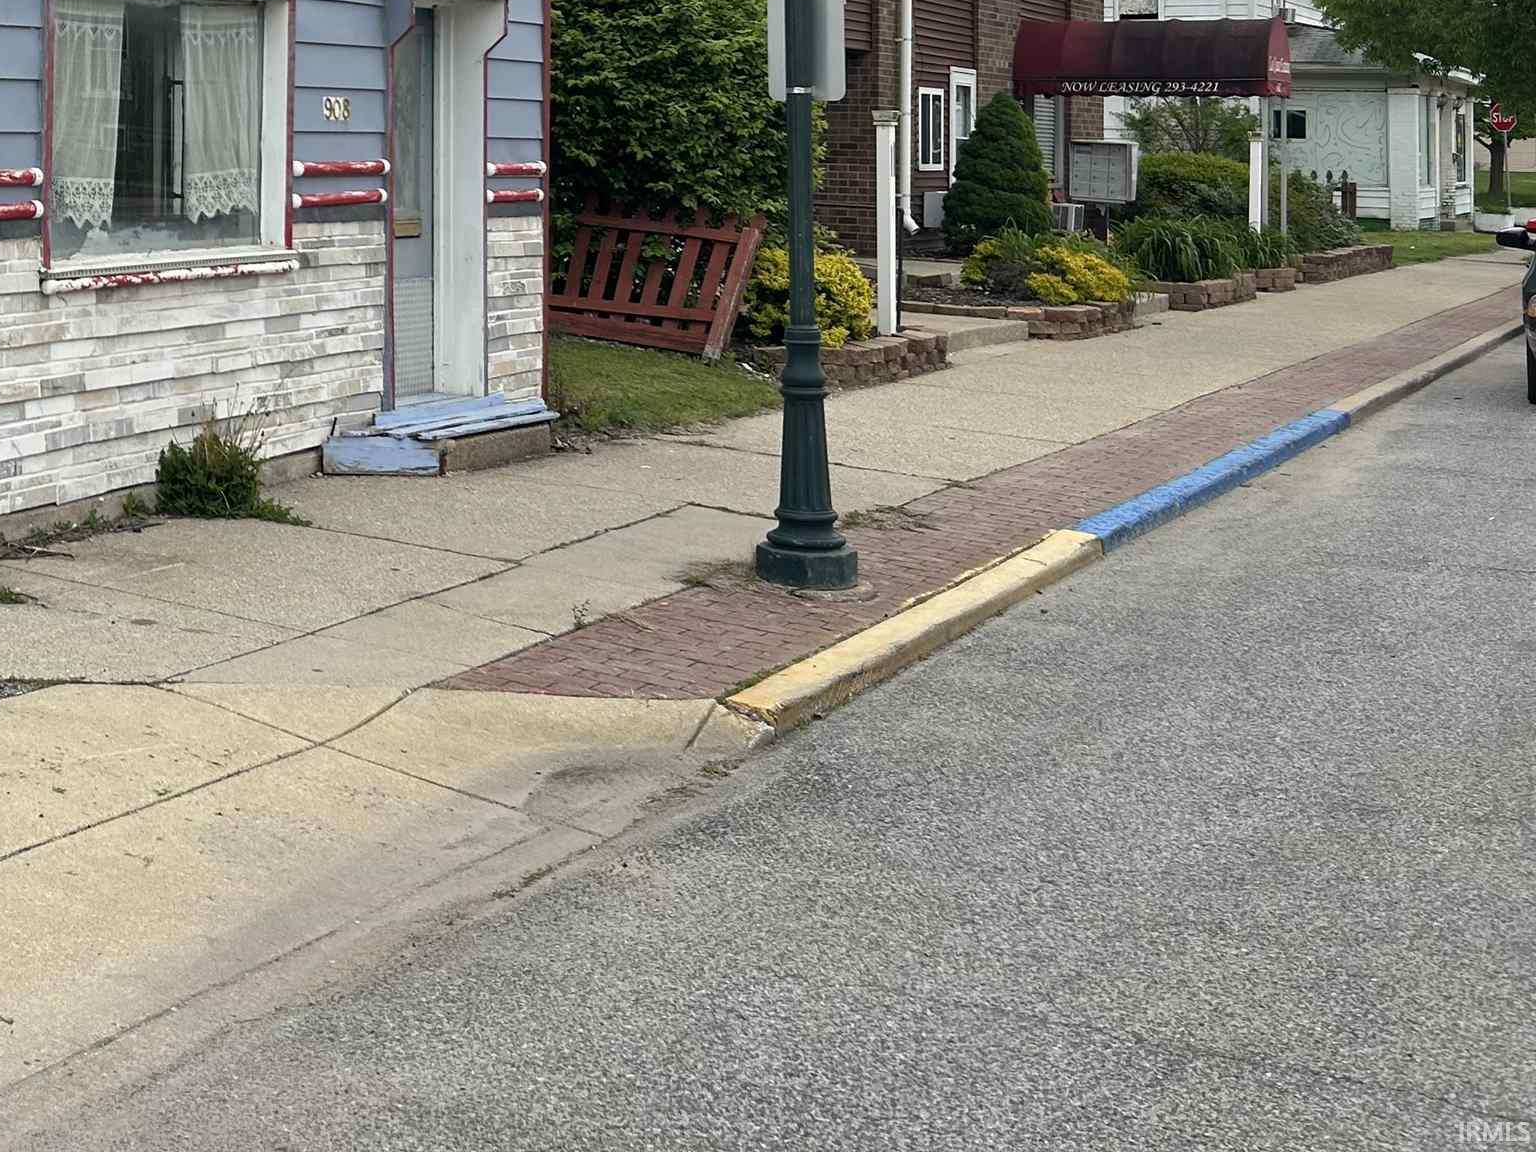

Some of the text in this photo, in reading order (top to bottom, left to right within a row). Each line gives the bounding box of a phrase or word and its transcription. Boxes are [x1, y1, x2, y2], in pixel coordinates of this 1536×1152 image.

[1060, 81, 1219, 95] NOW LEASING 293-4221
[325, 97, 350, 120] 908
